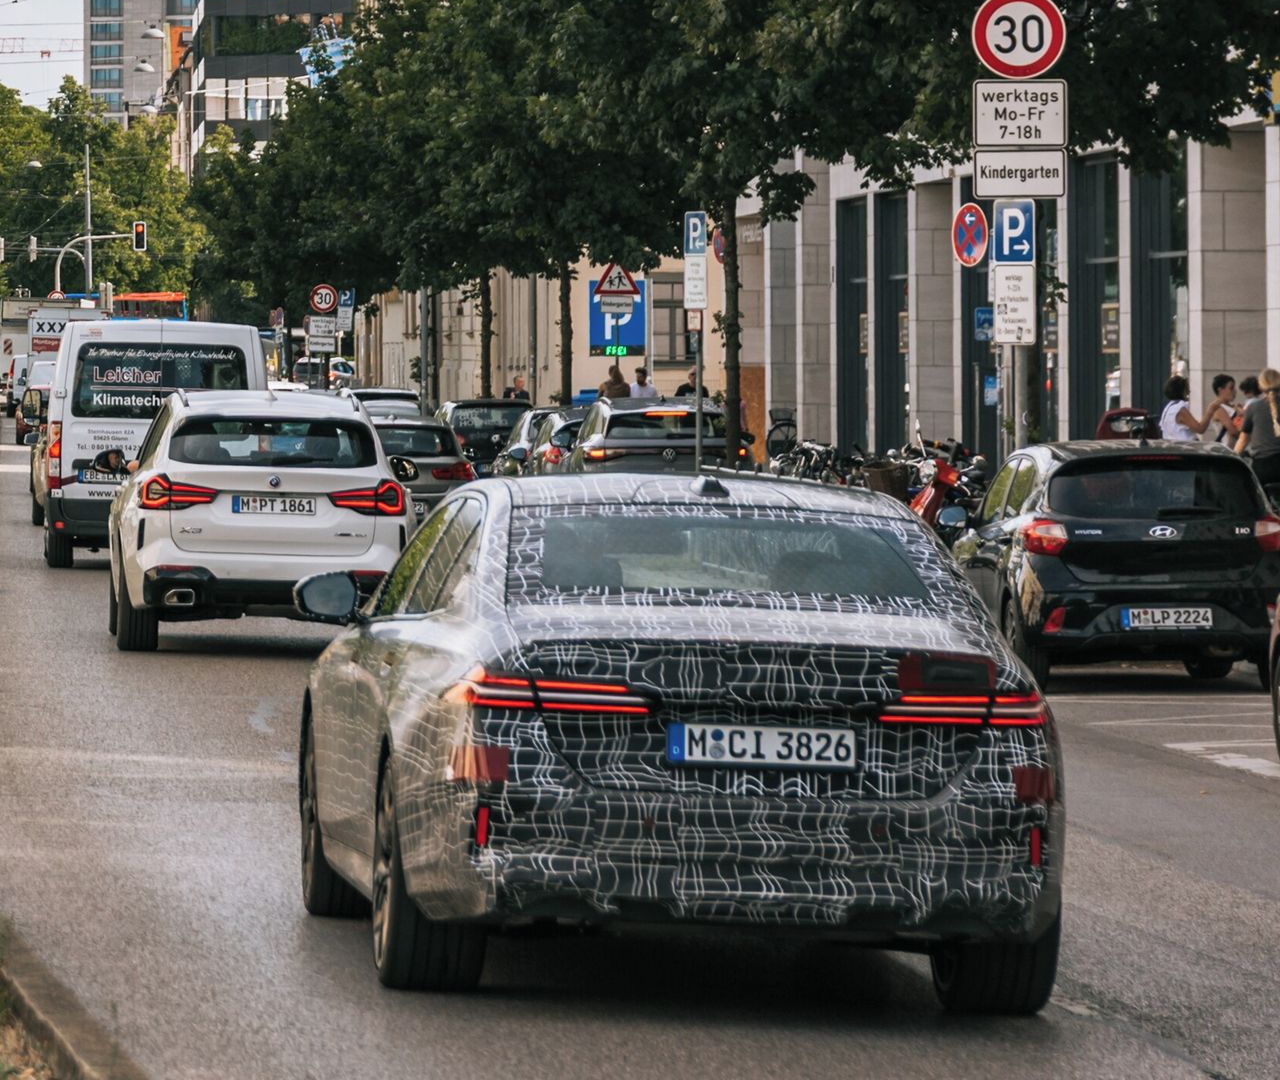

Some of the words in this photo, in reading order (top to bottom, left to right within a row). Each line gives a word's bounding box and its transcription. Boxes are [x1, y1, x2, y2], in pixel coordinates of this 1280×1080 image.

[994, 15, 1044, 54] 30
[982, 89, 1059, 107] werktags
[994, 107, 1045, 121] Mo-Fr
[980, 165, 1059, 182] Kindergarten
[689, 218, 701, 250] P
[1003, 208, 1025, 256] P
[316, 292, 332, 305] 30
[93, 366, 162, 384] Leicher
[84, 470, 100, 480] EBE
[241, 498, 250, 511] M
[259, 498, 277, 511] PT
[280, 499, 313, 513] 1861
[1131, 610, 1142, 624] M
[1151, 610, 1170, 624] LP
[1173, 610, 1210, 624] 2224
[688, 727, 707, 757] M
[728, 729, 766, 760] CI
[776, 731, 852, 762] 3826
